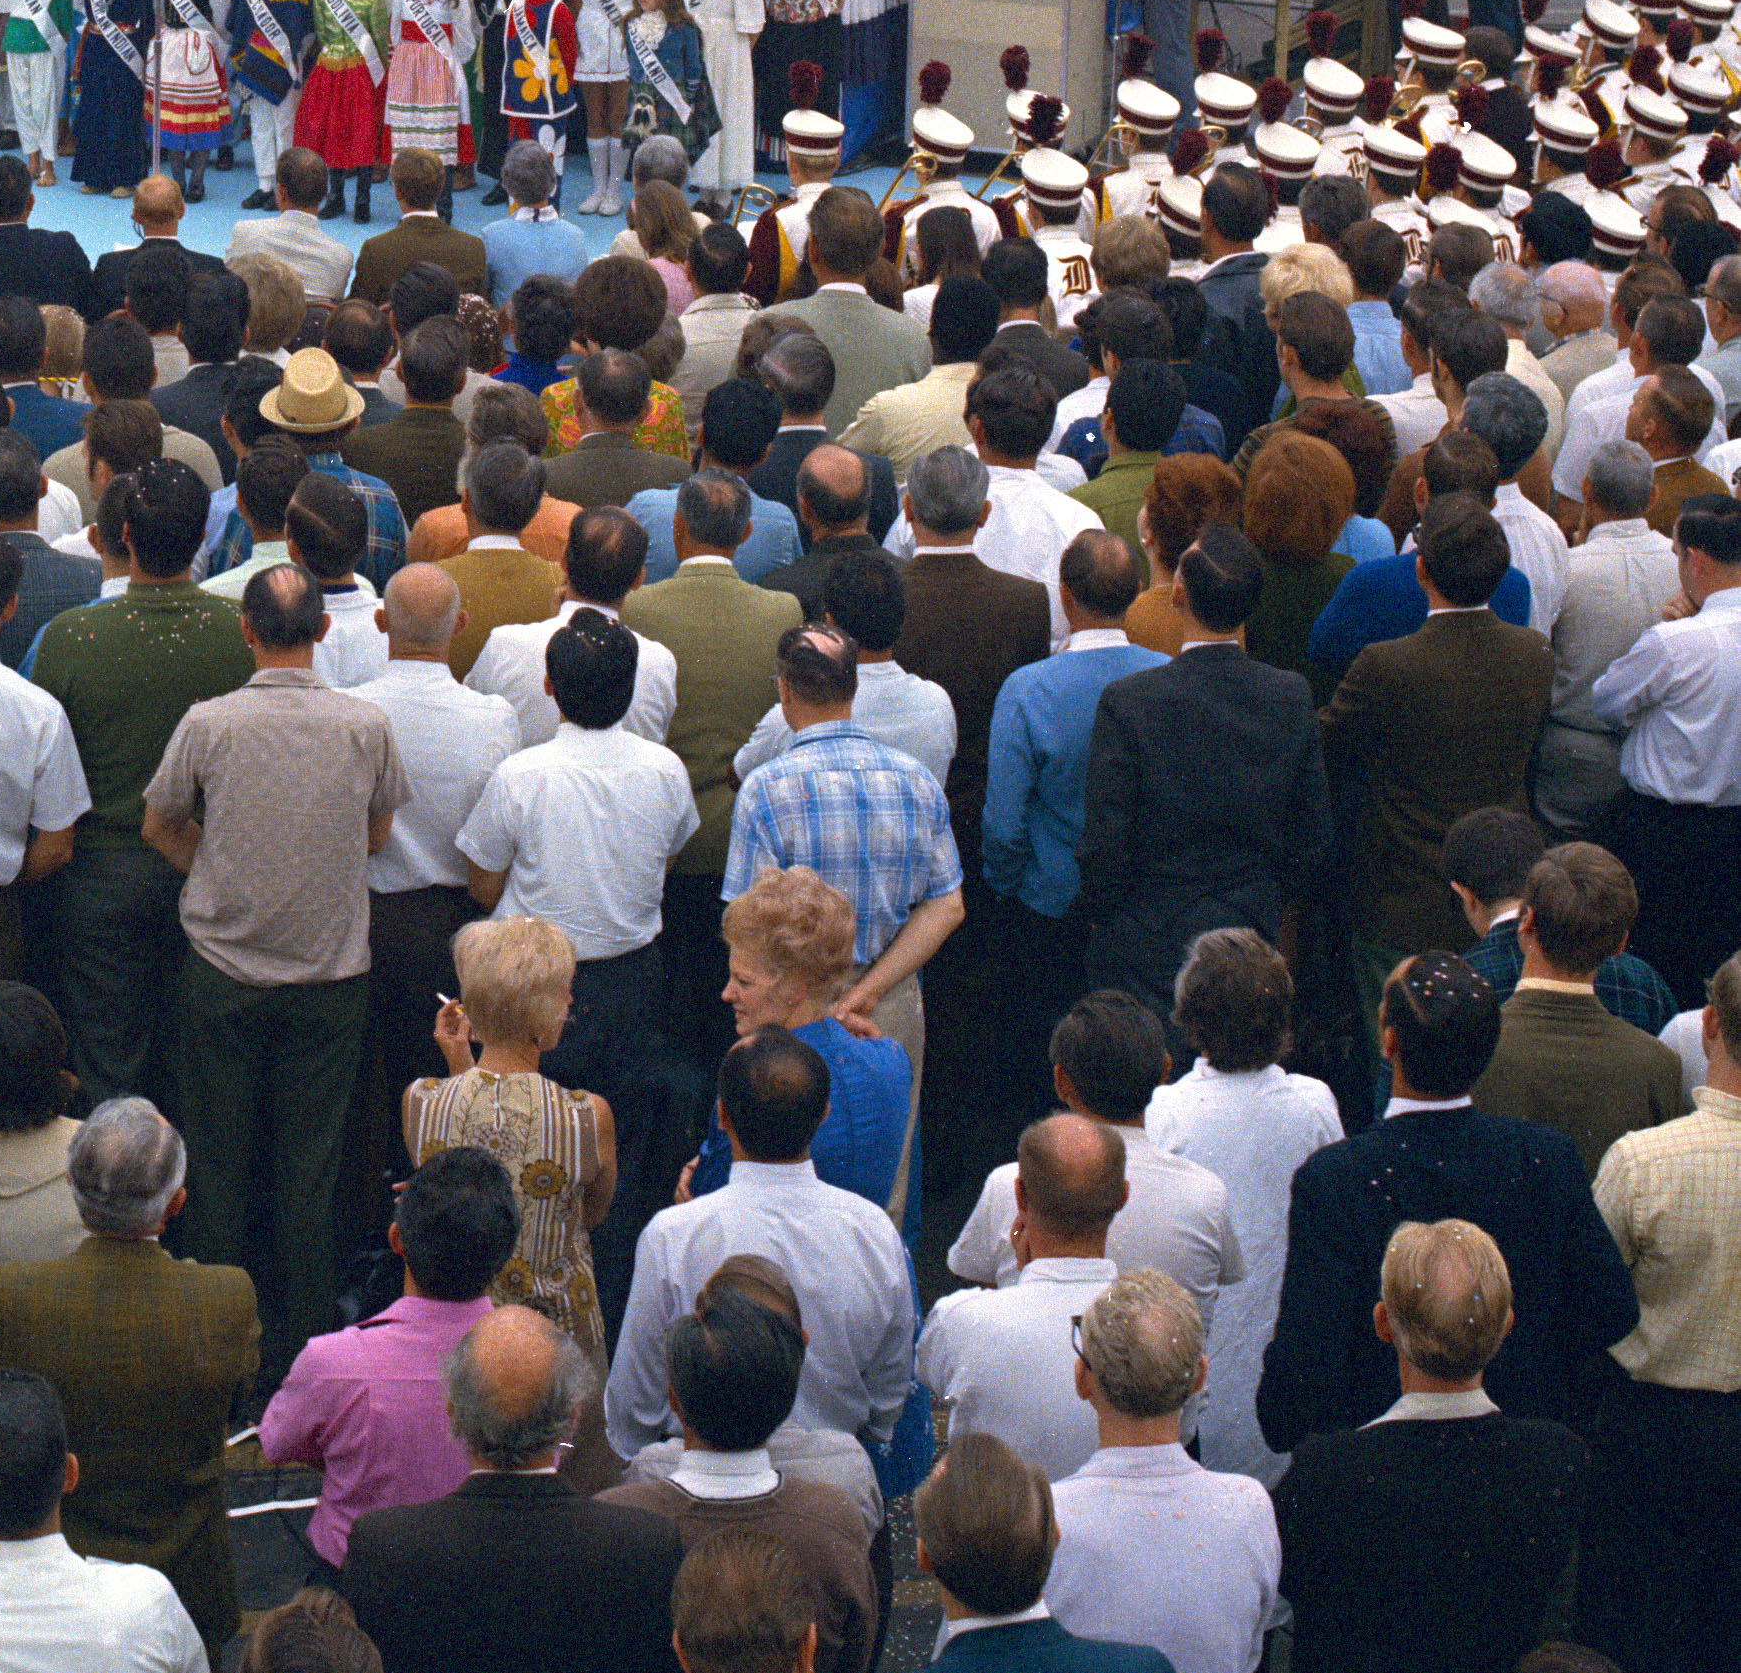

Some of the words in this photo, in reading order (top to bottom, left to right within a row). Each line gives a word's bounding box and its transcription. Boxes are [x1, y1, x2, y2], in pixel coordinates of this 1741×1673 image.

[108, 28, 136, 63] INDIAN
[512, 5, 538, 51] JAMAICA
[628, 23, 668, 85] SCOTLAND
[1055, 254, 1092, 298] D
